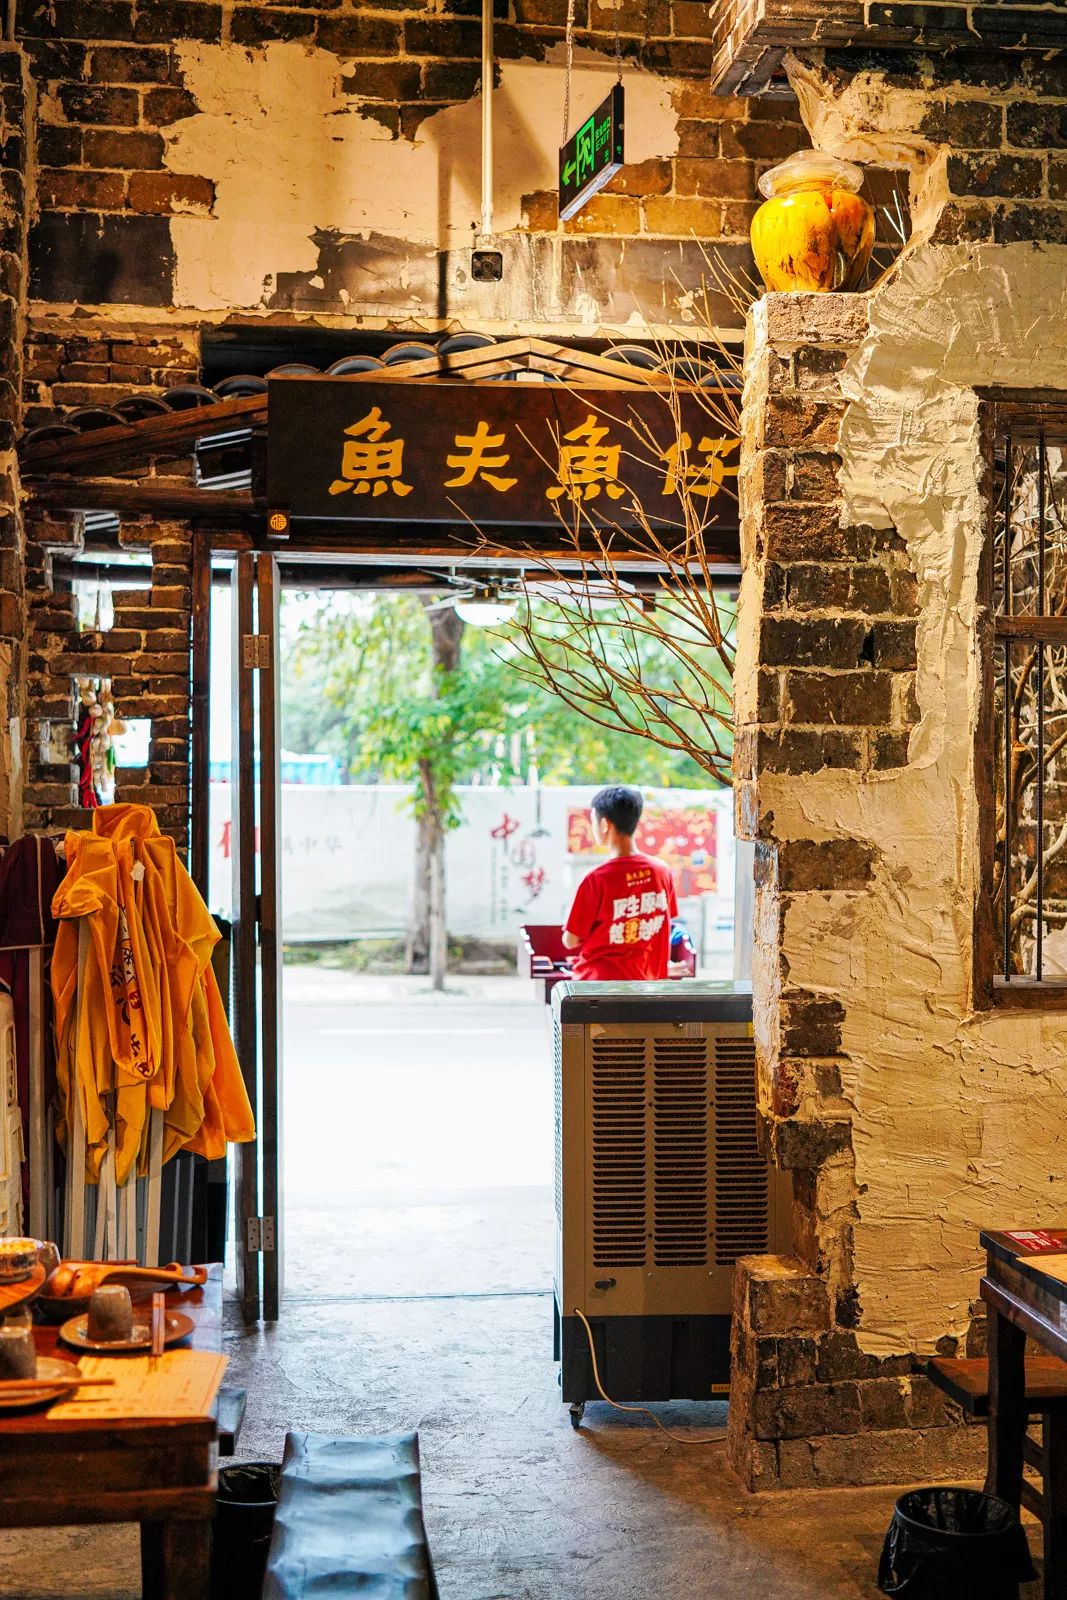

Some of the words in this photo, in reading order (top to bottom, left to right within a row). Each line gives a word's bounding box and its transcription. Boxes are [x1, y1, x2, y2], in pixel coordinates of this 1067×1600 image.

[595, 129, 611, 152] EXIT
[328, 406, 740, 500] 魚夫魚仔
